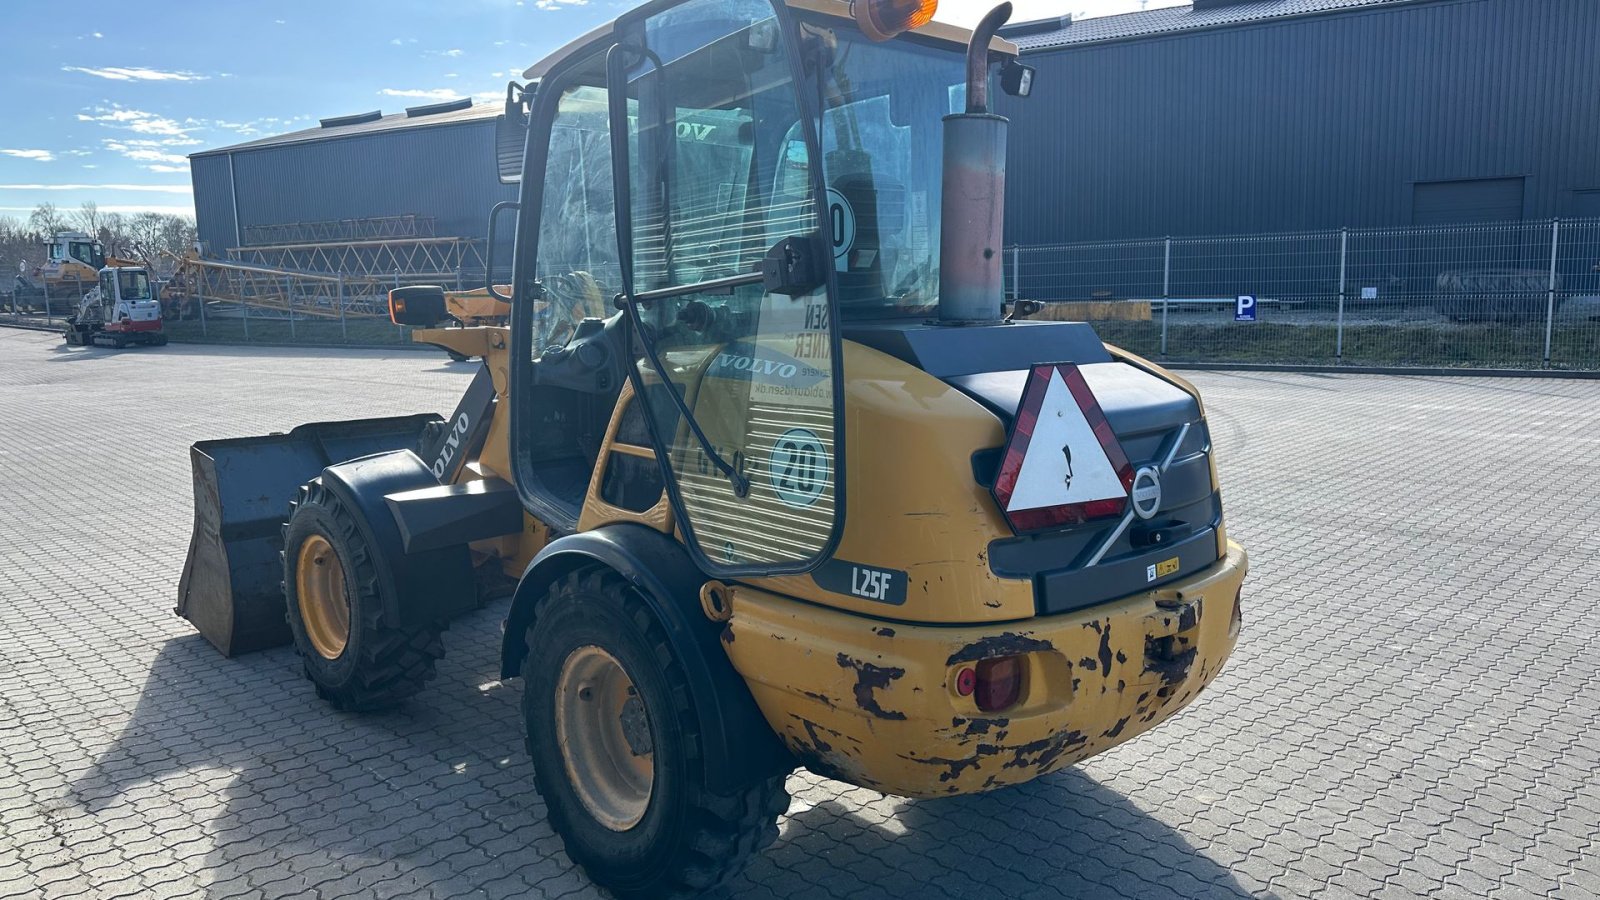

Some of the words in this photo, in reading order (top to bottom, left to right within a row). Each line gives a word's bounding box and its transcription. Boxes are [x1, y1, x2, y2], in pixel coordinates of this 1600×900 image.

[1237, 295, 1254, 315] P
[719, 353, 797, 378] VOLVO
[431, 412, 469, 479] OLVO
[780, 441, 816, 492] 20
[852, 567, 892, 600] L25F
